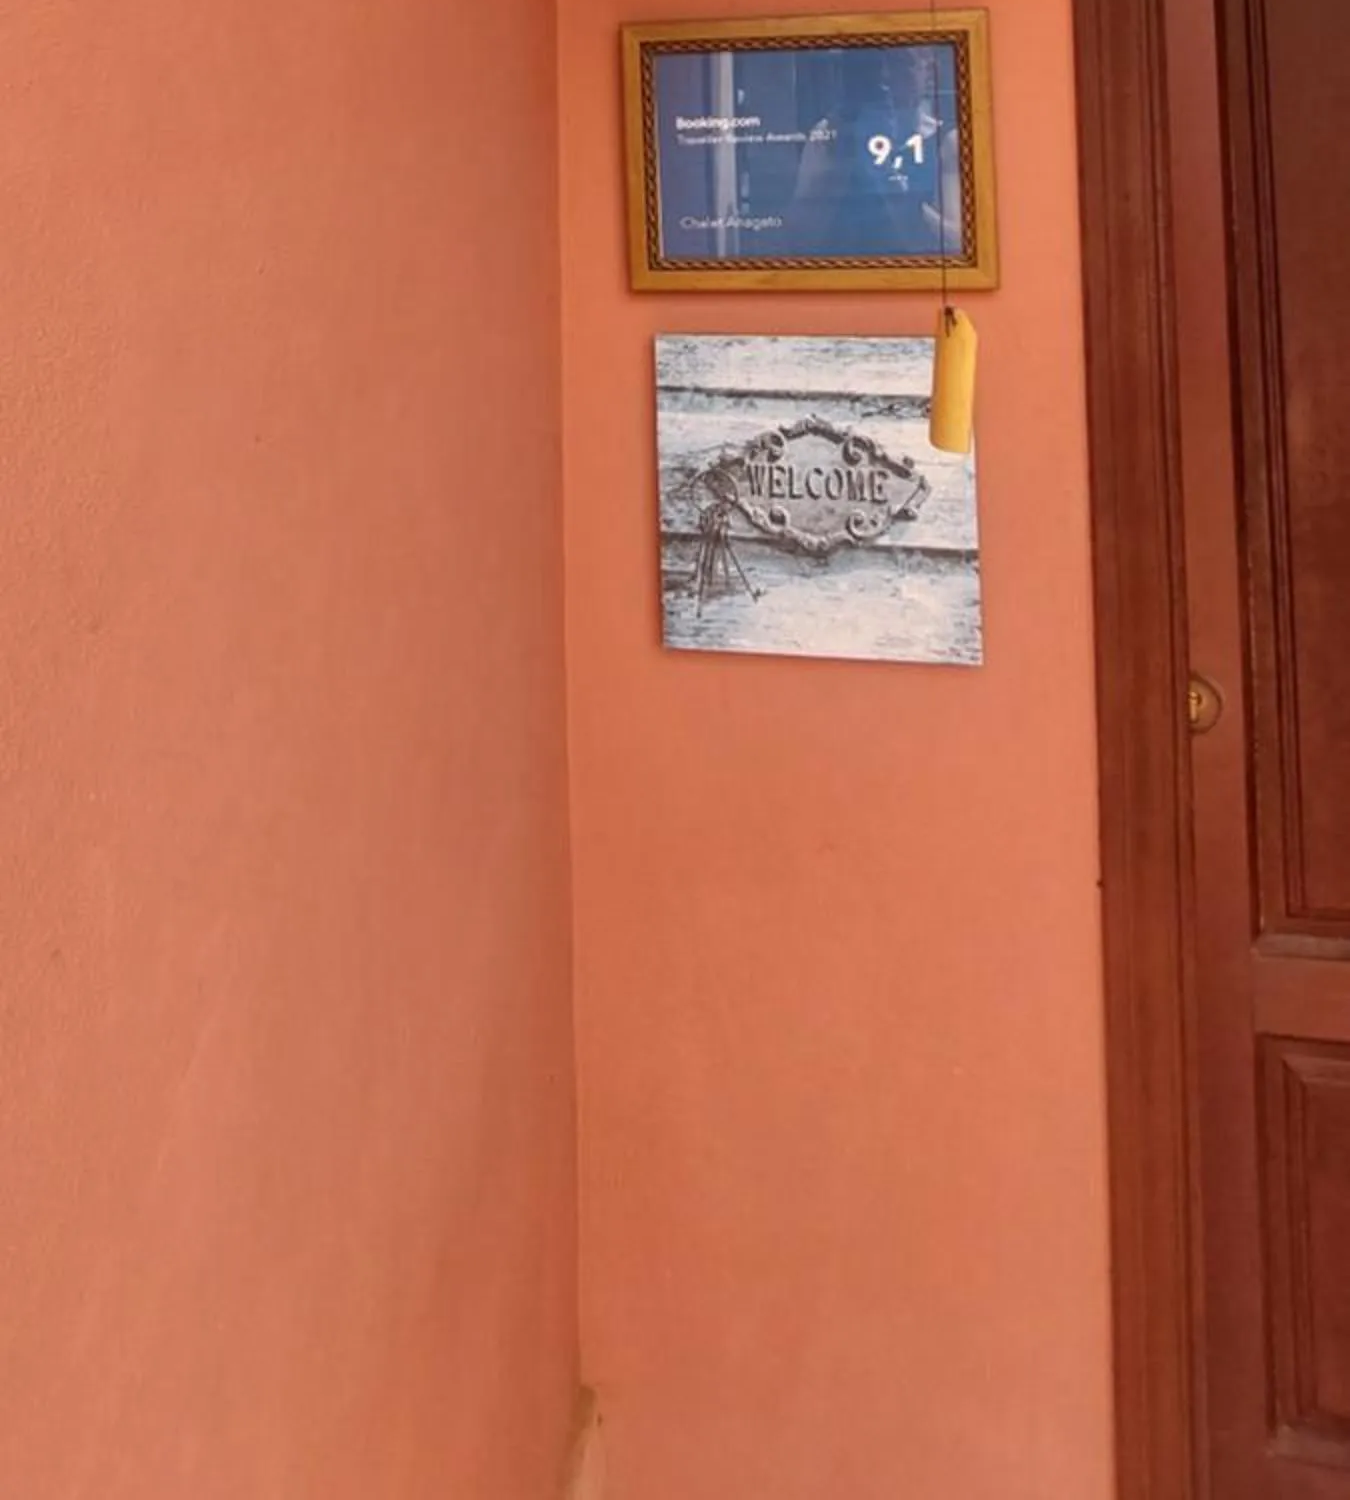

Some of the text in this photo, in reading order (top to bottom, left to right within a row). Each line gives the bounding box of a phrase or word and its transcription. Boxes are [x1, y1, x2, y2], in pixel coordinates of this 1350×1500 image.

[676, 116, 761, 130] Booking.com
[868, 133, 924, 169] 9,1
[747, 464, 889, 504] WELCOME
